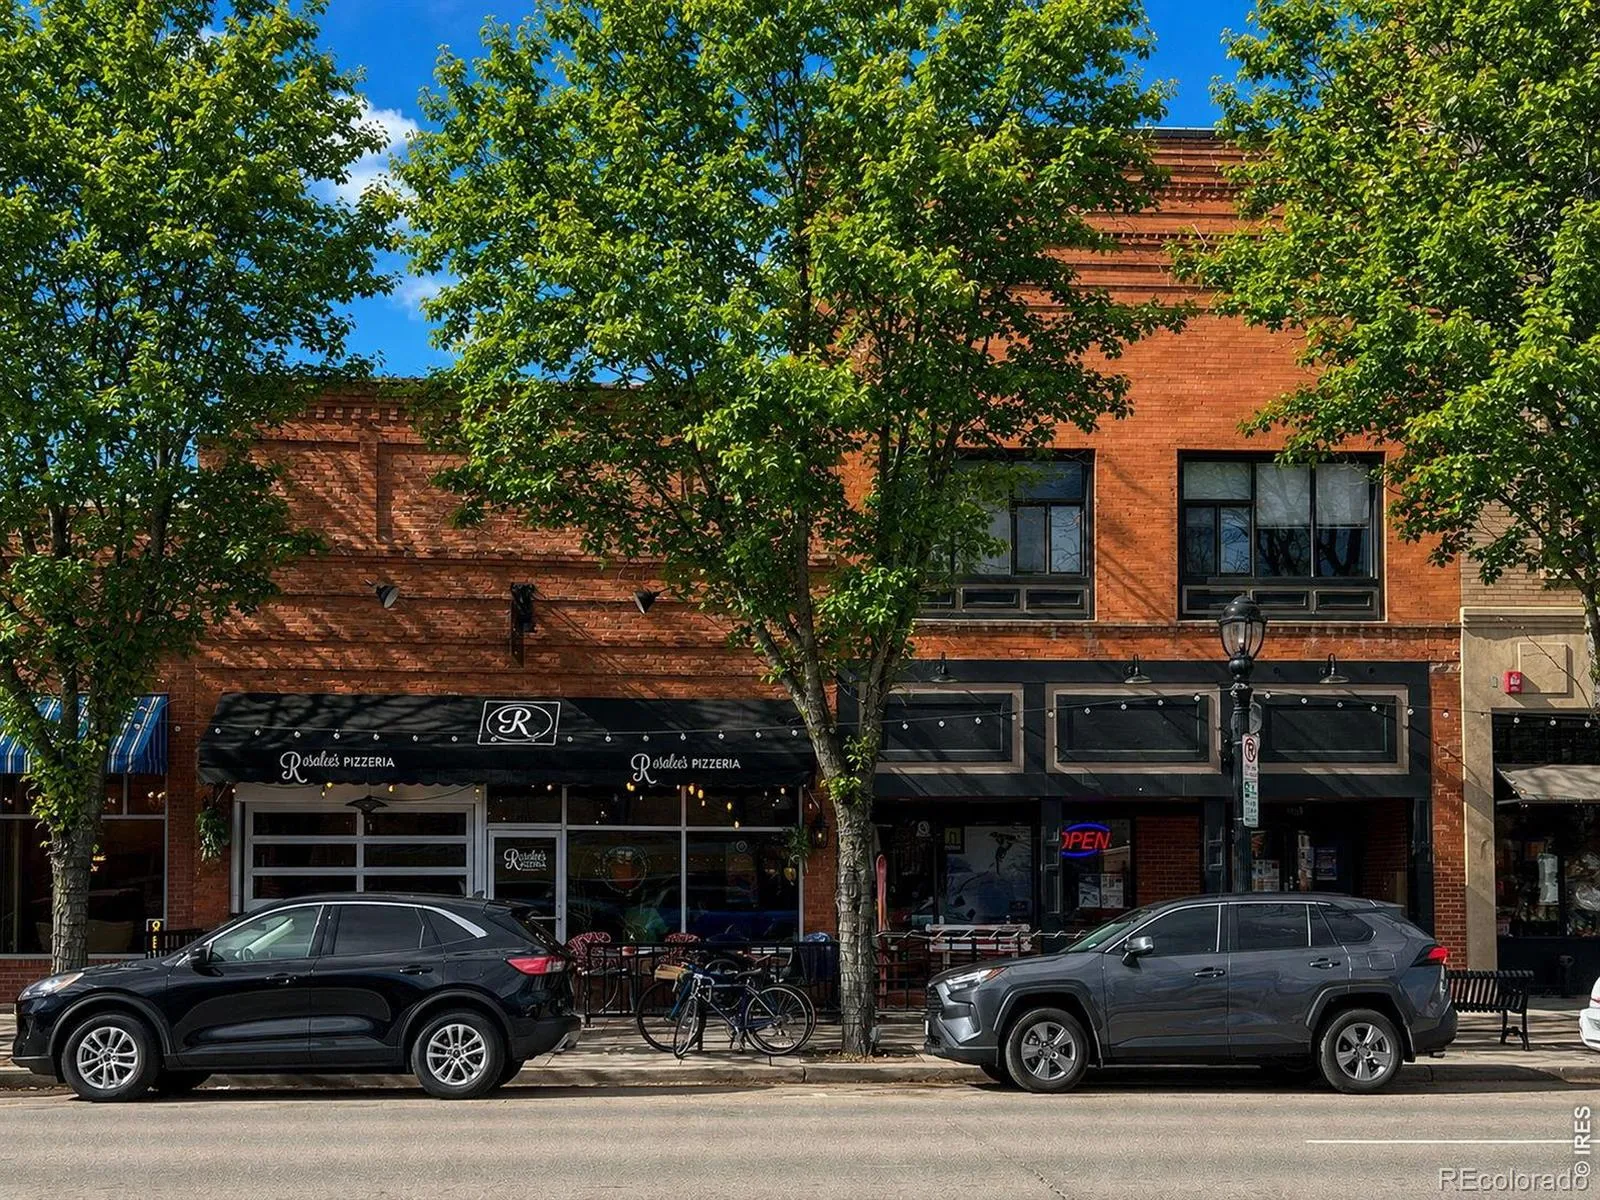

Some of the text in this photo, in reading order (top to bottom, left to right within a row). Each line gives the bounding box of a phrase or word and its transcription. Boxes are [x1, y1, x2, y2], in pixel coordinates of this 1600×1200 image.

[498, 707, 539, 738] R
[280, 750, 395, 783] Rosalee's PIZZERIA
[631, 753, 741, 784] Rosalee's PIZZERIA
